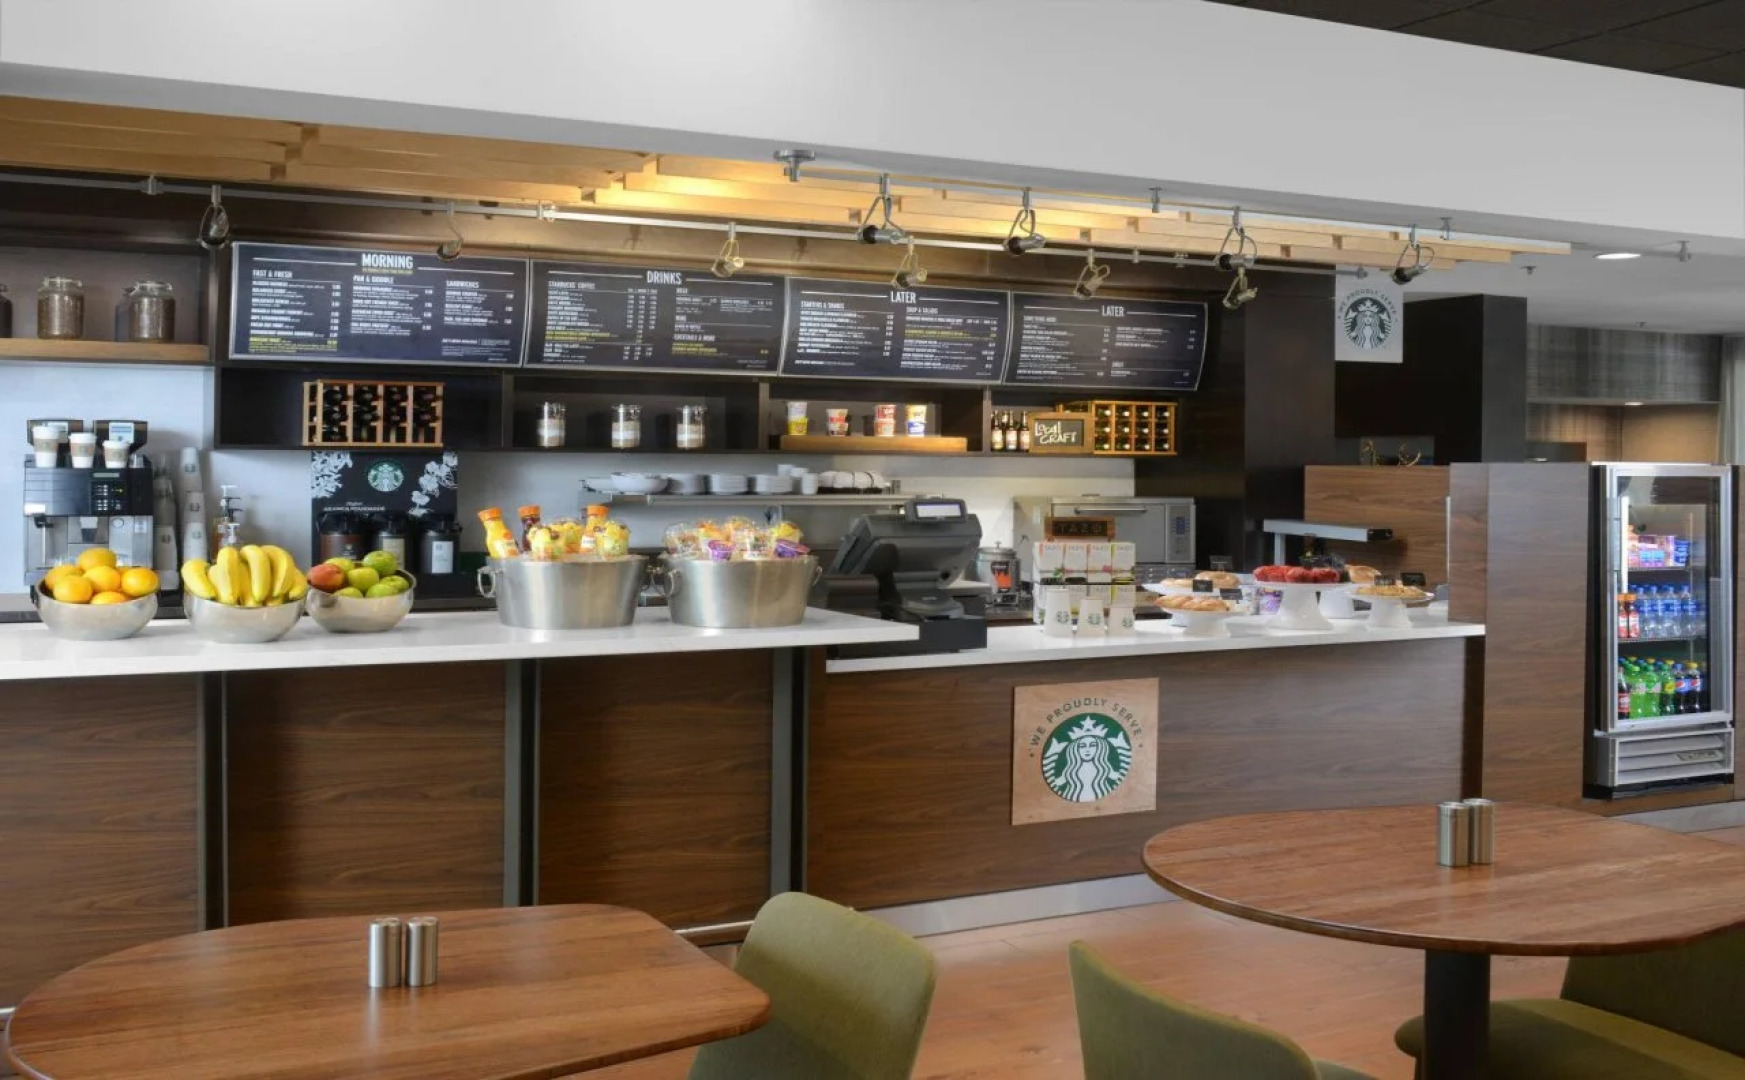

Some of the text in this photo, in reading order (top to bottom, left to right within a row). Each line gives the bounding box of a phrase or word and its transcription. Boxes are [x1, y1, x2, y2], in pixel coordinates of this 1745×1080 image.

[361, 253, 414, 269] MORNING
[646, 270, 683, 285] DRINKS
[890, 291, 917, 304] LATER
[1102, 305, 1125, 318] LATER
[1039, 431, 1078, 445] CRAFT
[1031, 697, 1143, 747] WE PROUDLY SERVE
